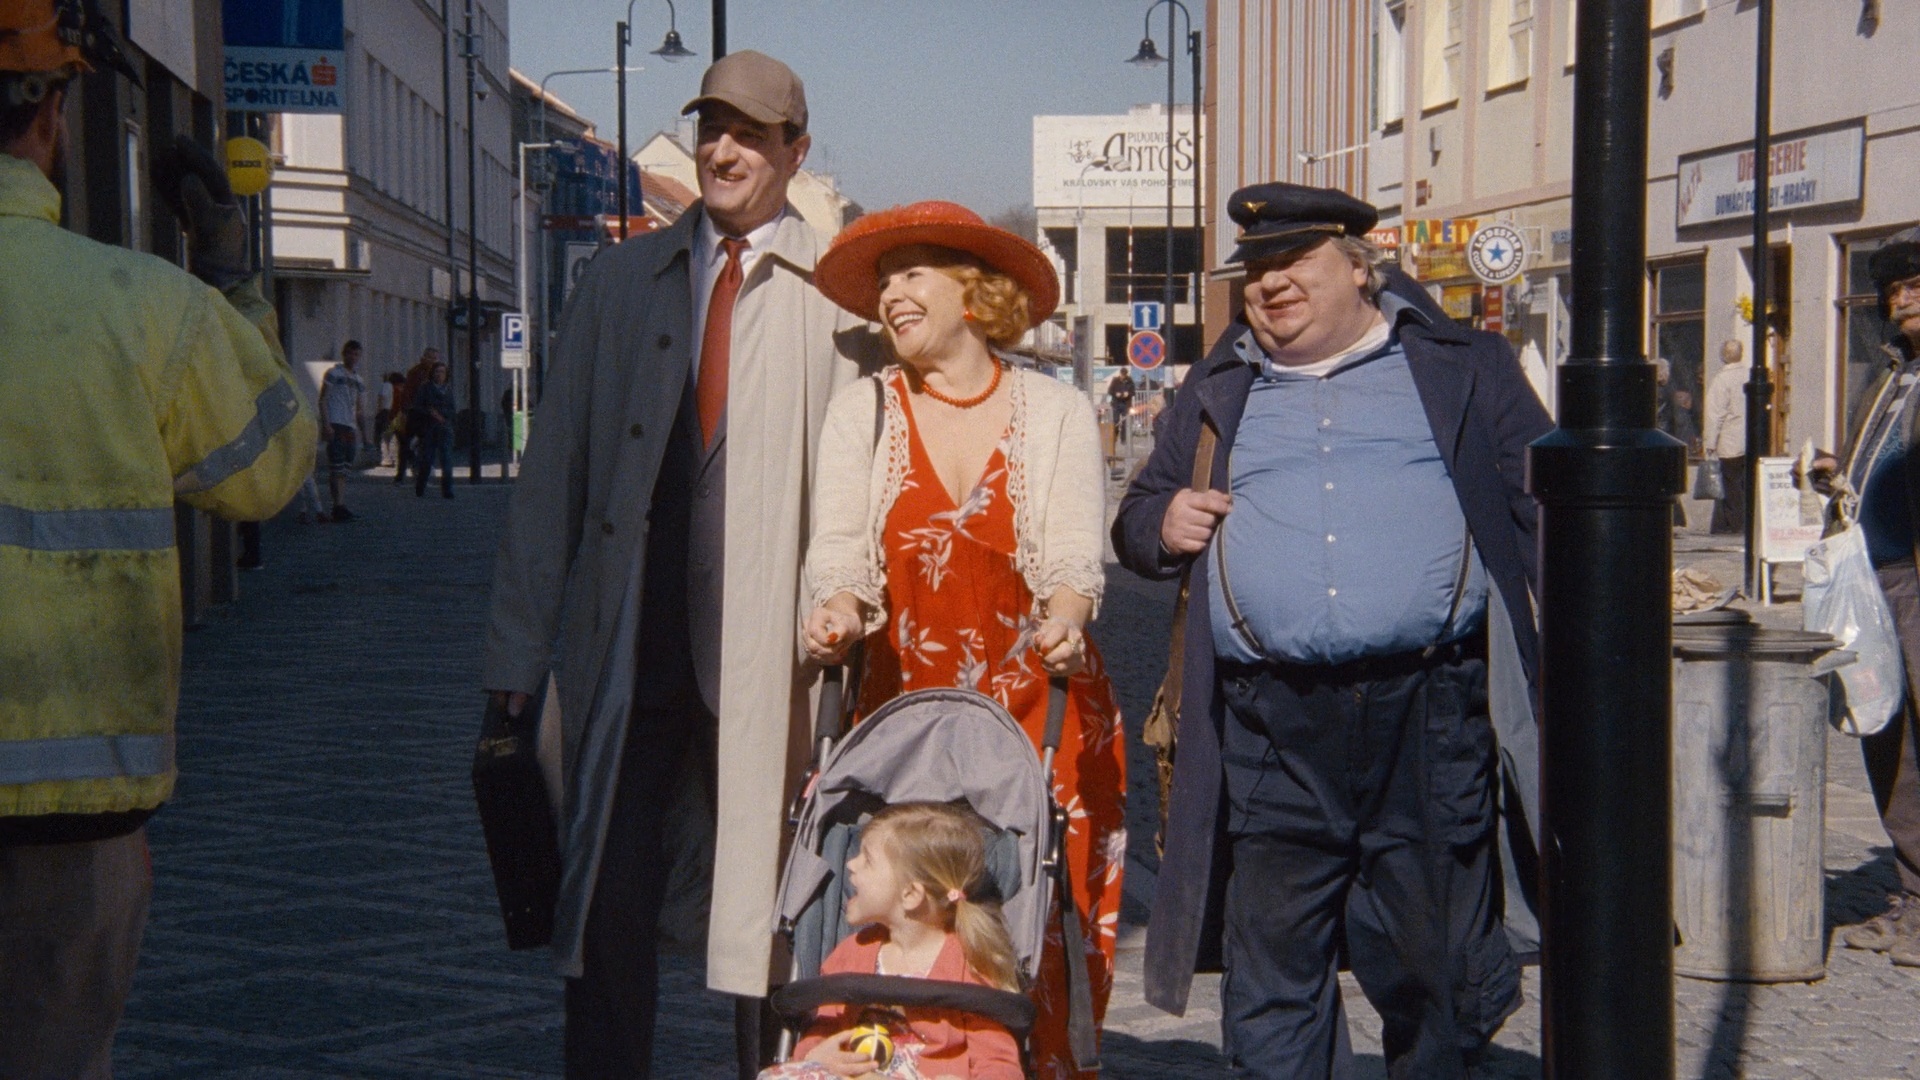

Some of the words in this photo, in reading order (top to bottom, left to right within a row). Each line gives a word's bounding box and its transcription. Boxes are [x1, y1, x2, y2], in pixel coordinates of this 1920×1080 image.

[224, 56, 310, 85] ČESKÁ
[224, 84, 339, 107] SPOŘITELNA
[1737, 140, 1807, 182] DRGERIE
[1405, 219, 1478, 243] TAPETY
[1474, 228, 1522, 250] LODESTAR
[508, 318, 523, 340] P
